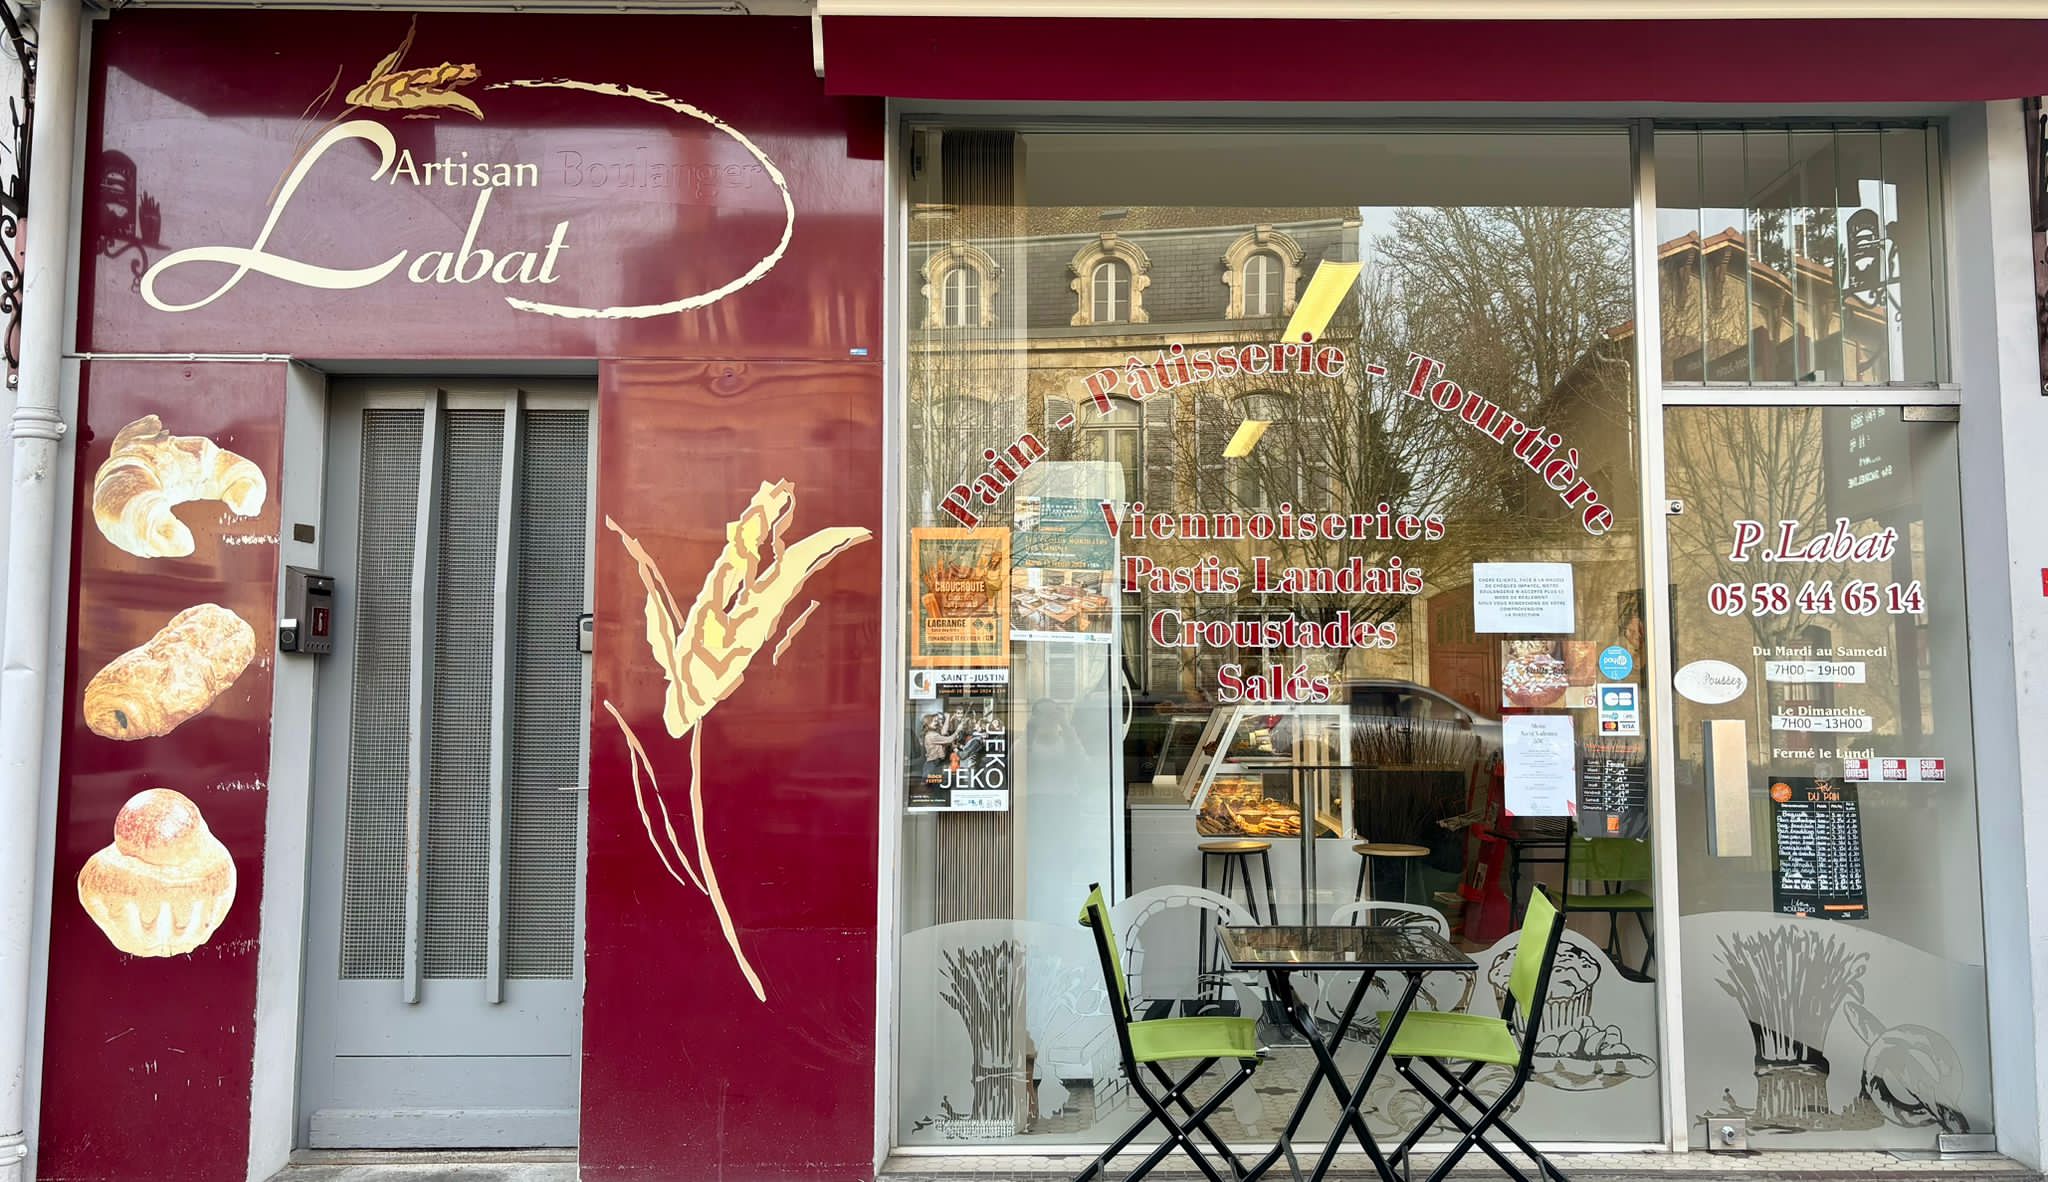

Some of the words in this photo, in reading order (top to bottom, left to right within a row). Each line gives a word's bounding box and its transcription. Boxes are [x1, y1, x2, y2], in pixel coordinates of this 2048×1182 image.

[390, 149, 538, 187] Artisan
[140, 119, 569, 312] Labat
[937, 432, 1049, 532] Pain
[1081, 331, 1346, 417] Pâtisserie
[1403, 352, 1614, 535] Tourtière
[1098, 500, 1445, 541] Viennoiseries
[1122, 555, 1241, 594] Pastis
[1251, 555, 1424, 595] Landais
[935, 581, 985, 592] CHOUCROUTE
[1708, 582, 1746, 616] 05
[1751, 582, 1790, 616] 58
[1797, 580, 1835, 614] 44
[1841, 580, 1880, 616] 65
[1886, 580, 1925, 614] 14
[927, 619, 966, 627] LAGRANGE
[1149, 608, 1398, 648] Croustades
[1752, 646, 1771, 657] Du
[1775, 646, 1812, 657] Mardi
[1816, 648, 1832, 657] au
[1837, 645, 1888, 657] Samedi
[1774, 664, 1805, 676] 7H00
[1817, 665, 1856, 676] 19H00
[1218, 662, 1330, 703] Salés
[1777, 706, 1795, 716] Le
[1798, 705, 1866, 716] Dimanche
[1781, 718, 1811, 729] 7H00
[1825, 718, 1863, 729] 13H00
[1773, 748, 1815, 758] Fermé
[1819, 748, 1832, 758] le
[1836, 747, 1875, 759] Lundi
[939, 768, 1004, 789] JEKO
[1807, 792, 1819, 801] DU
